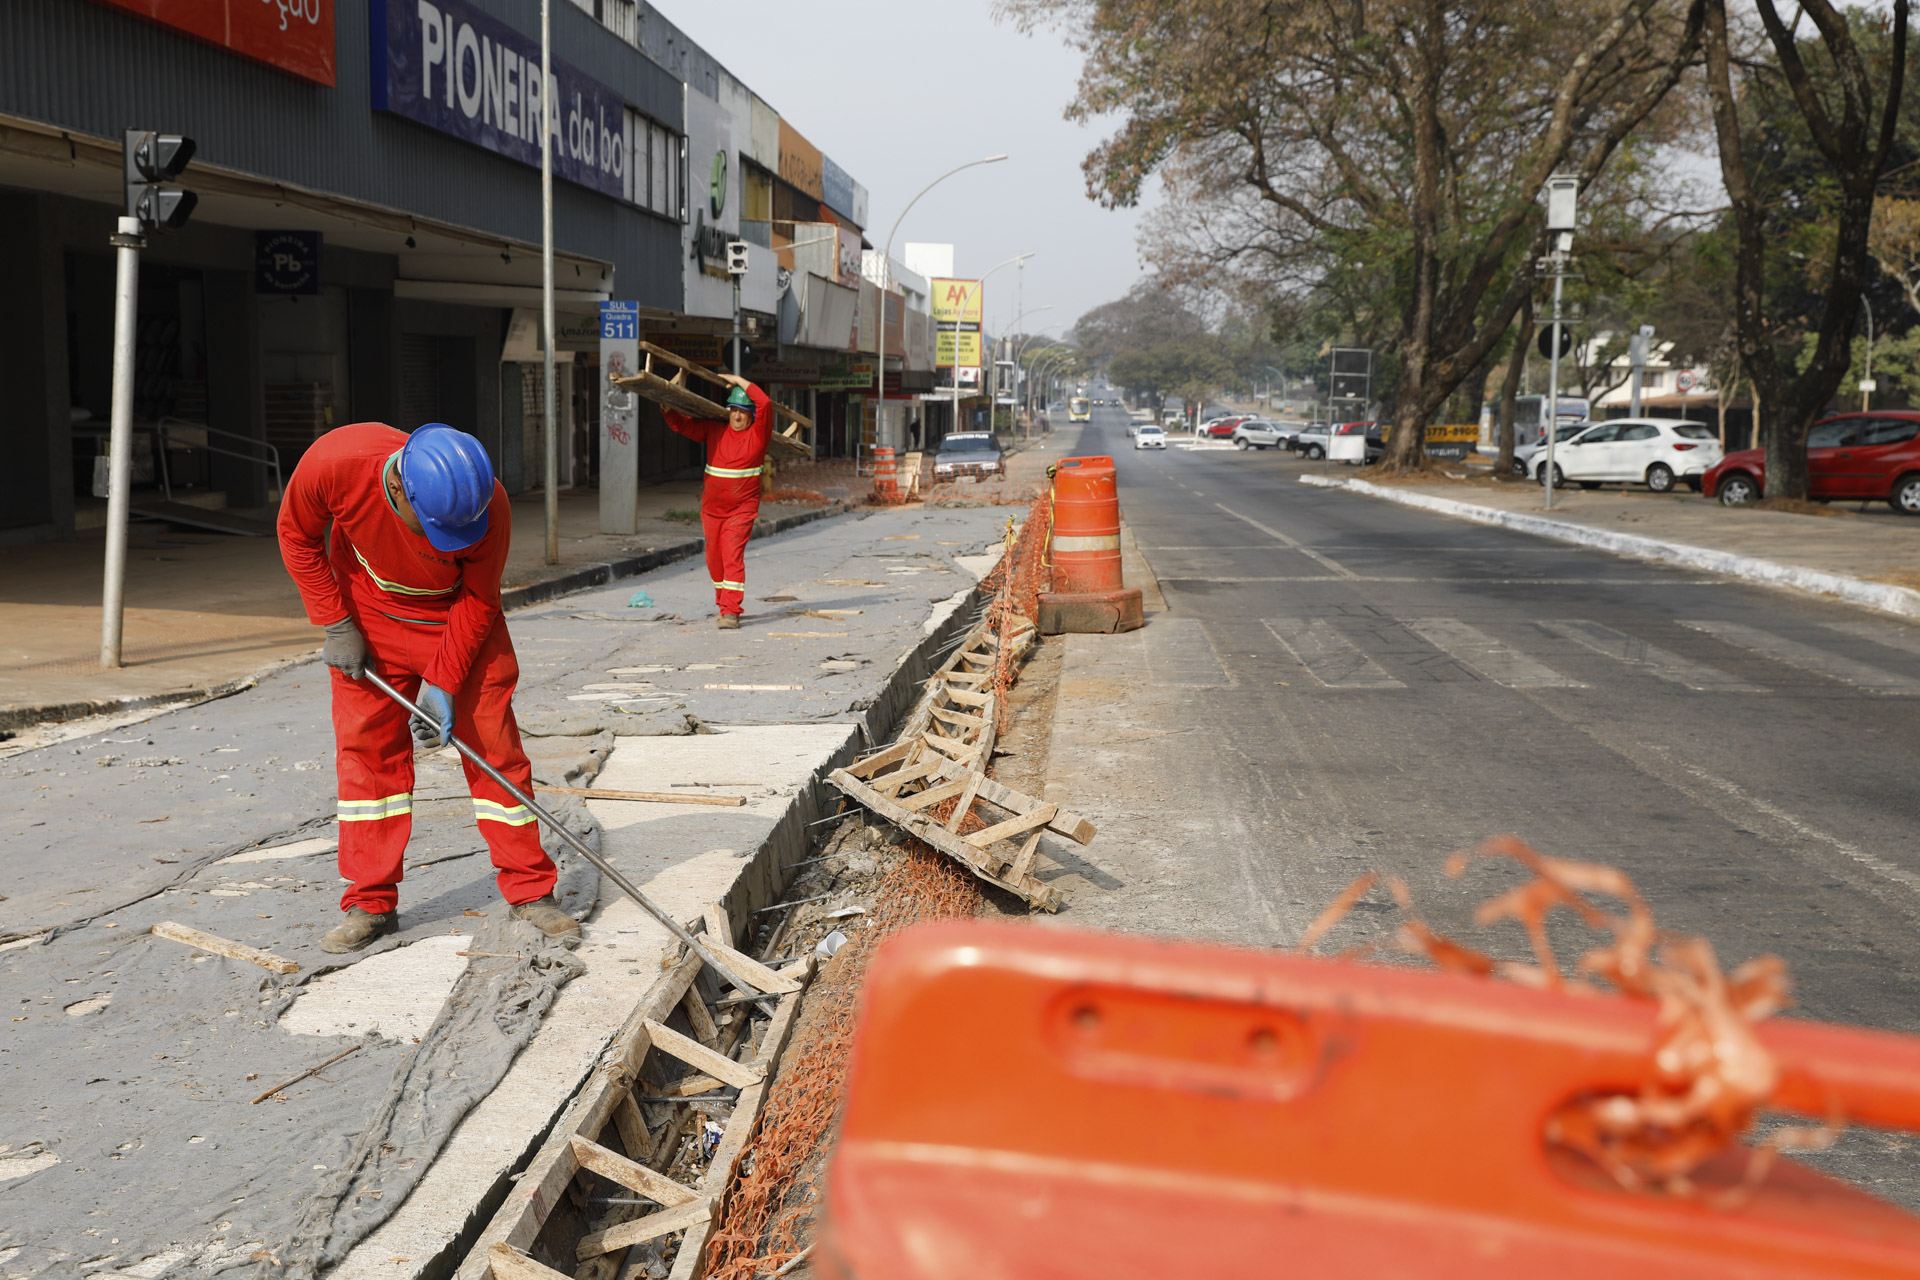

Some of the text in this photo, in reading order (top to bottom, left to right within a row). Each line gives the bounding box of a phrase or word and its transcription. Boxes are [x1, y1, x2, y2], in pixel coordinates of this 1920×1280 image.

[418, 0, 624, 178] PIONEIRA da bo
[273, 254, 302, 272] Pb
[609, 301, 629, 310] SUL
[605, 313, 632, 321] Quadra
[604, 323, 635, 338] 511
